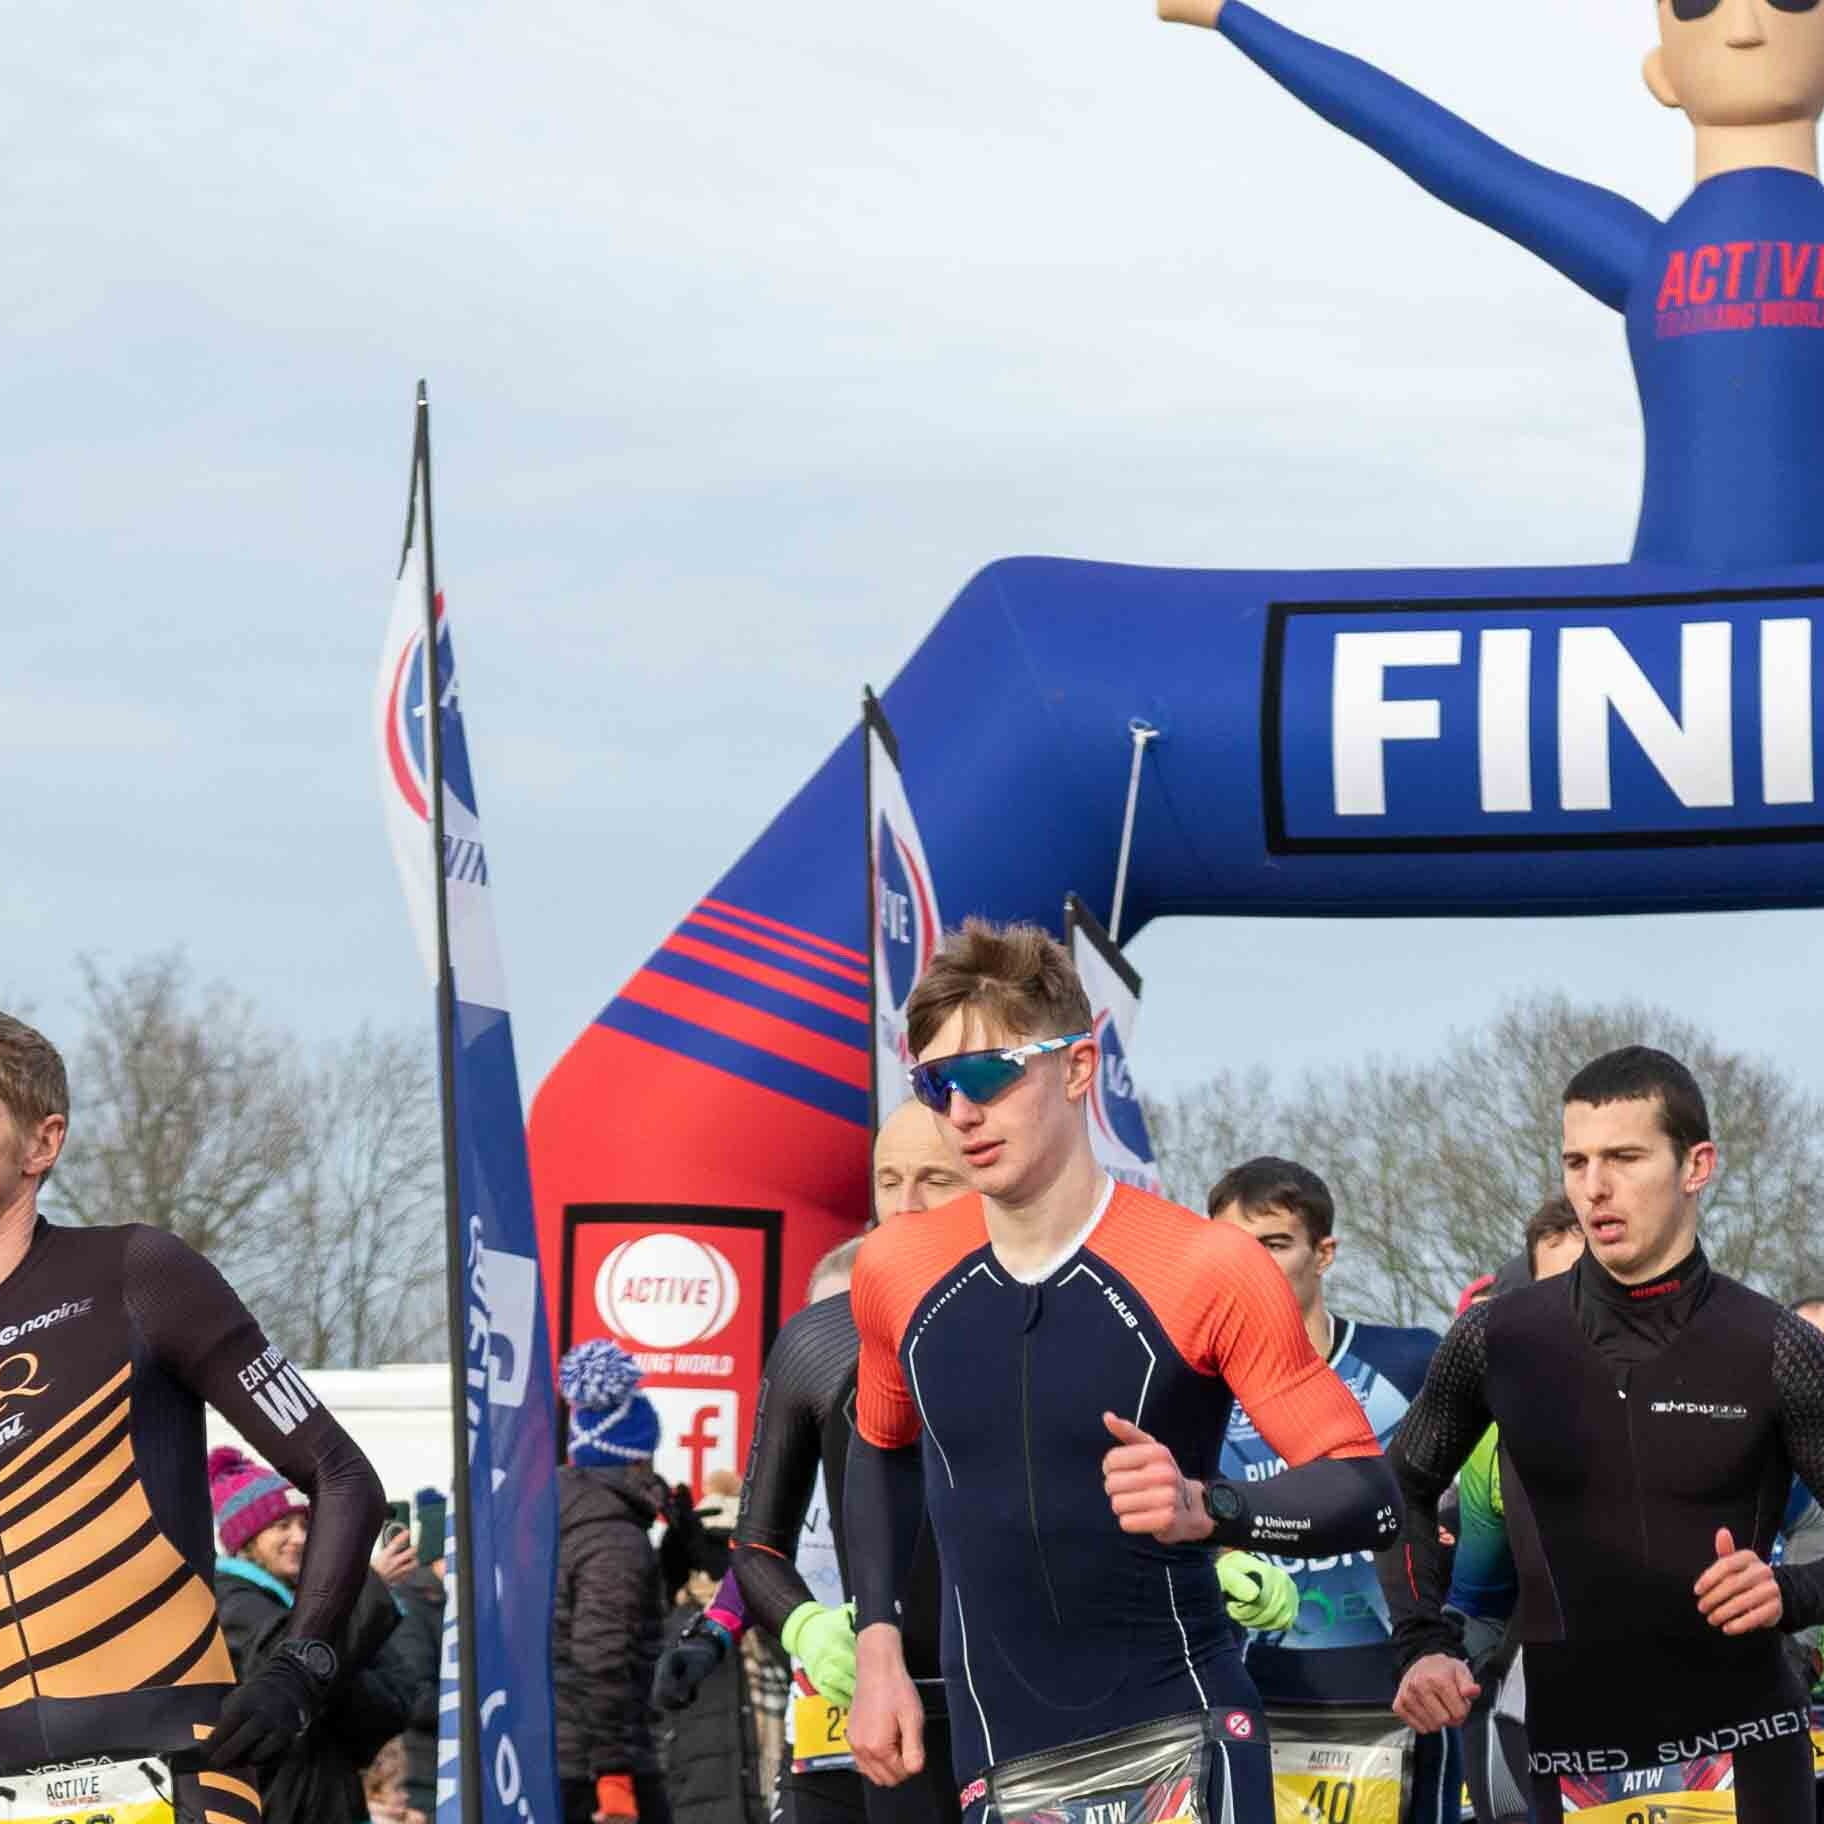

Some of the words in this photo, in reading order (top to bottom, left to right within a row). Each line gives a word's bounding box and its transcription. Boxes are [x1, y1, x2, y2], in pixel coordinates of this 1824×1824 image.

[620, 1276, 714, 1305] ACTIVE
[1103, 1286, 1139, 1329] HUUB
[237, 1358, 268, 1391] EAT
[676, 1354, 735, 1376] WORLD
[1264, 1515, 1312, 1531] Universal
[1658, 1711, 1800, 1764] SUNDRIED
[45, 1776, 101, 1801] ACTIVE
[1623, 1767, 1664, 1793] ATW
